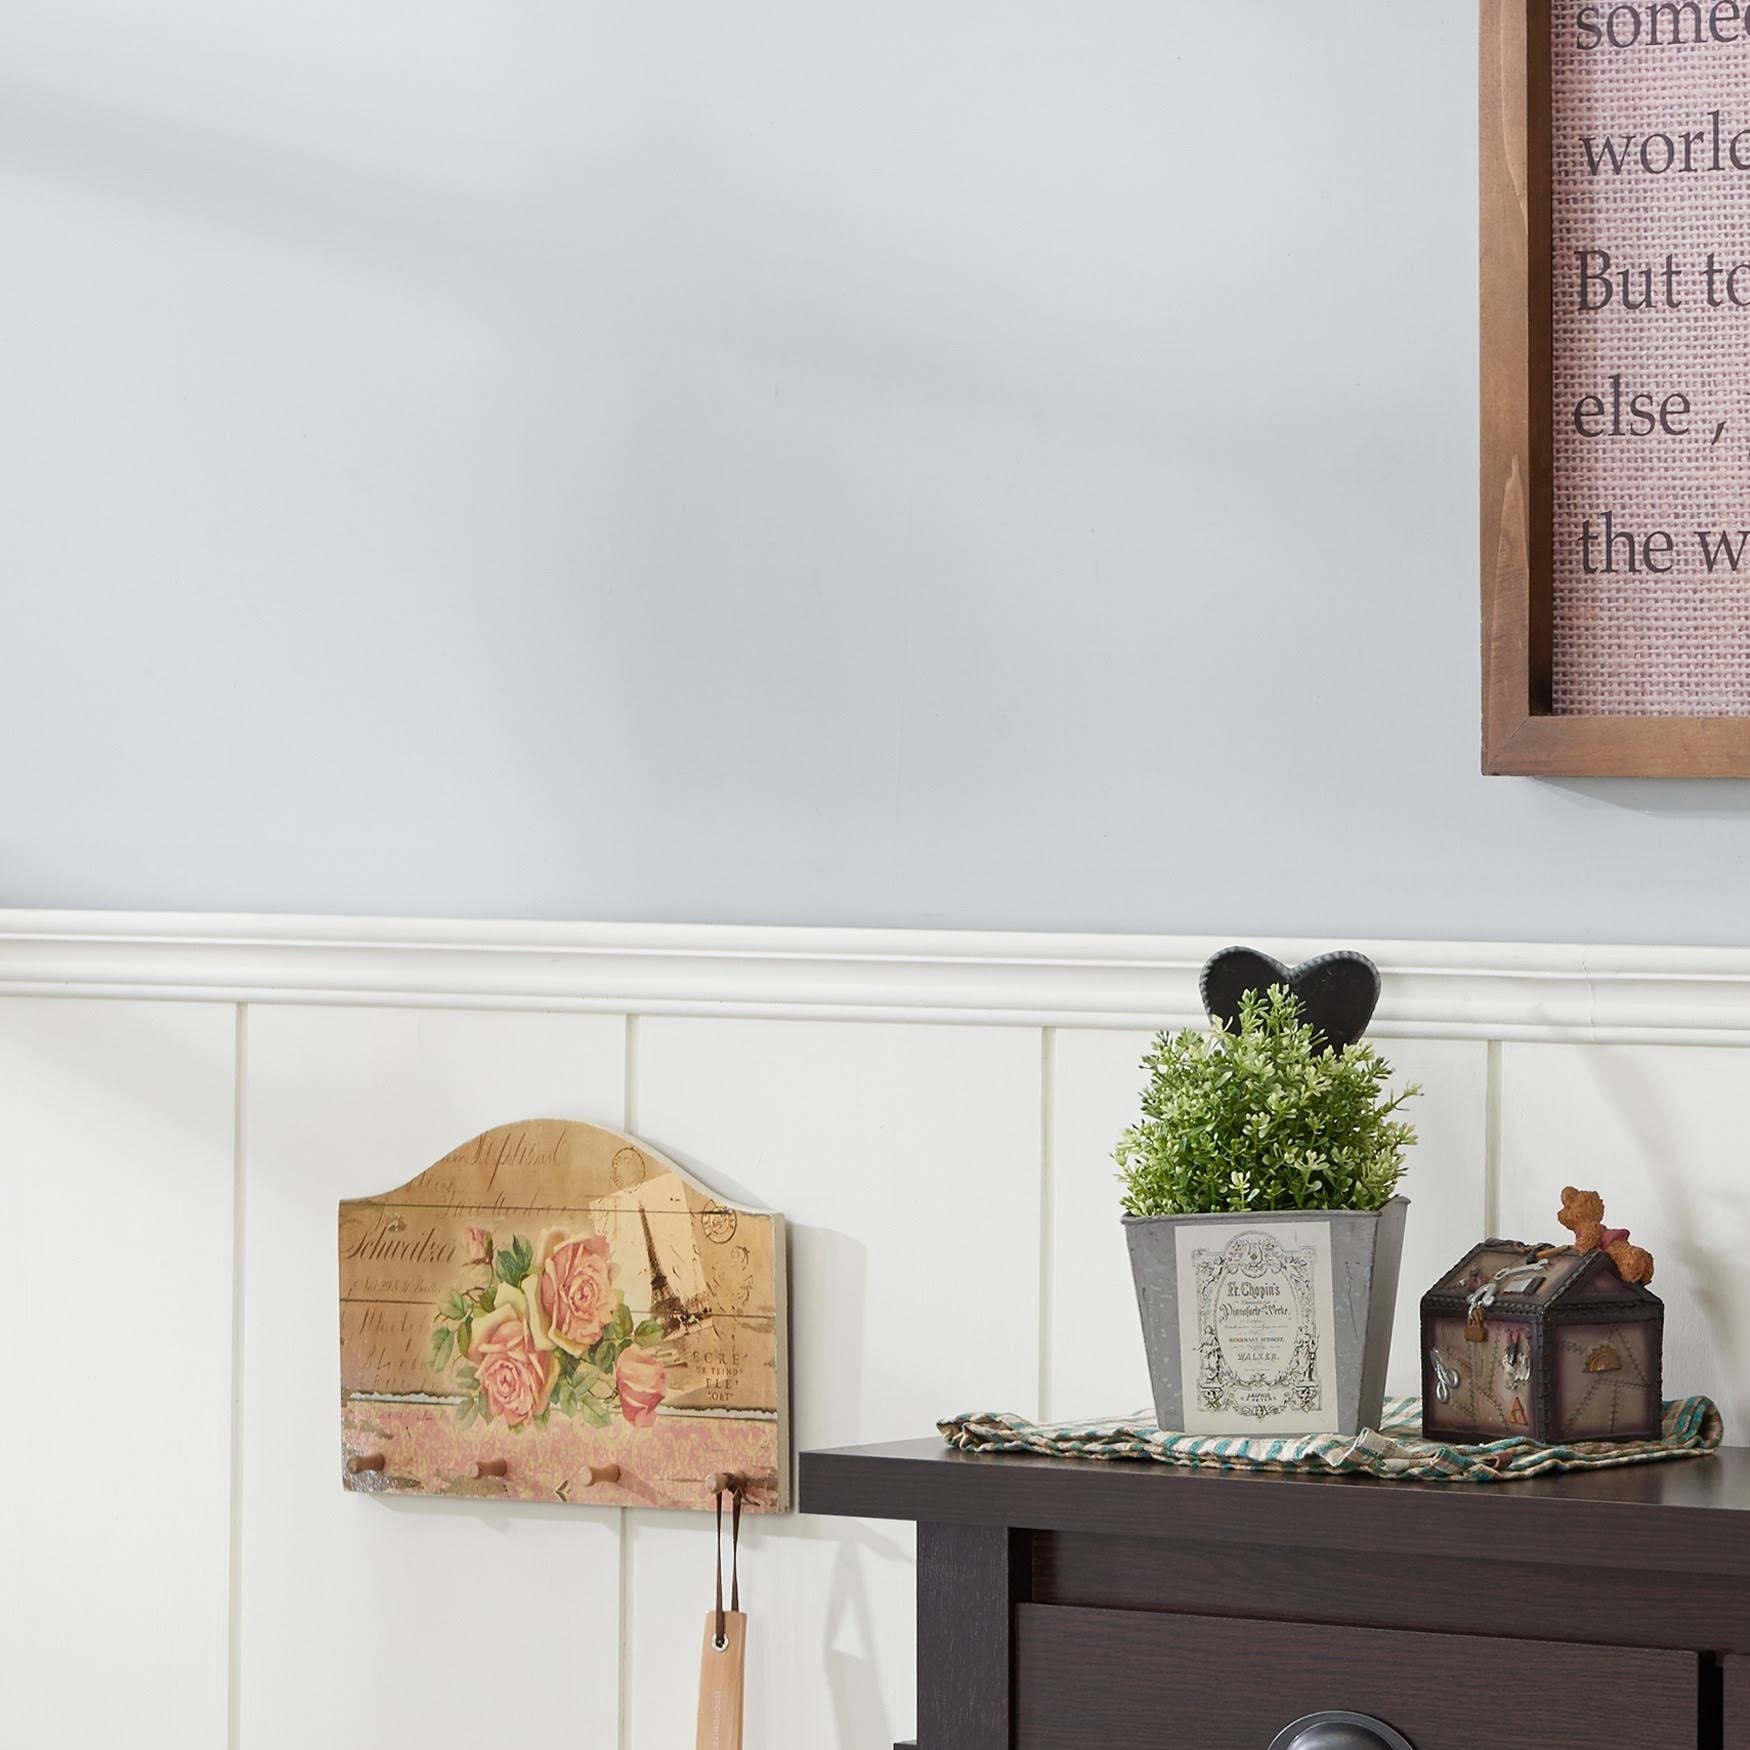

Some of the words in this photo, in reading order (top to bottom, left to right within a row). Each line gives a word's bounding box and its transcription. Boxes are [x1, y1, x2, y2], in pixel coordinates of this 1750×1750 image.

[1573, 249, 1683, 311] But
[1573, 374, 1692, 438] else
[1577, 510, 1675, 574] the
